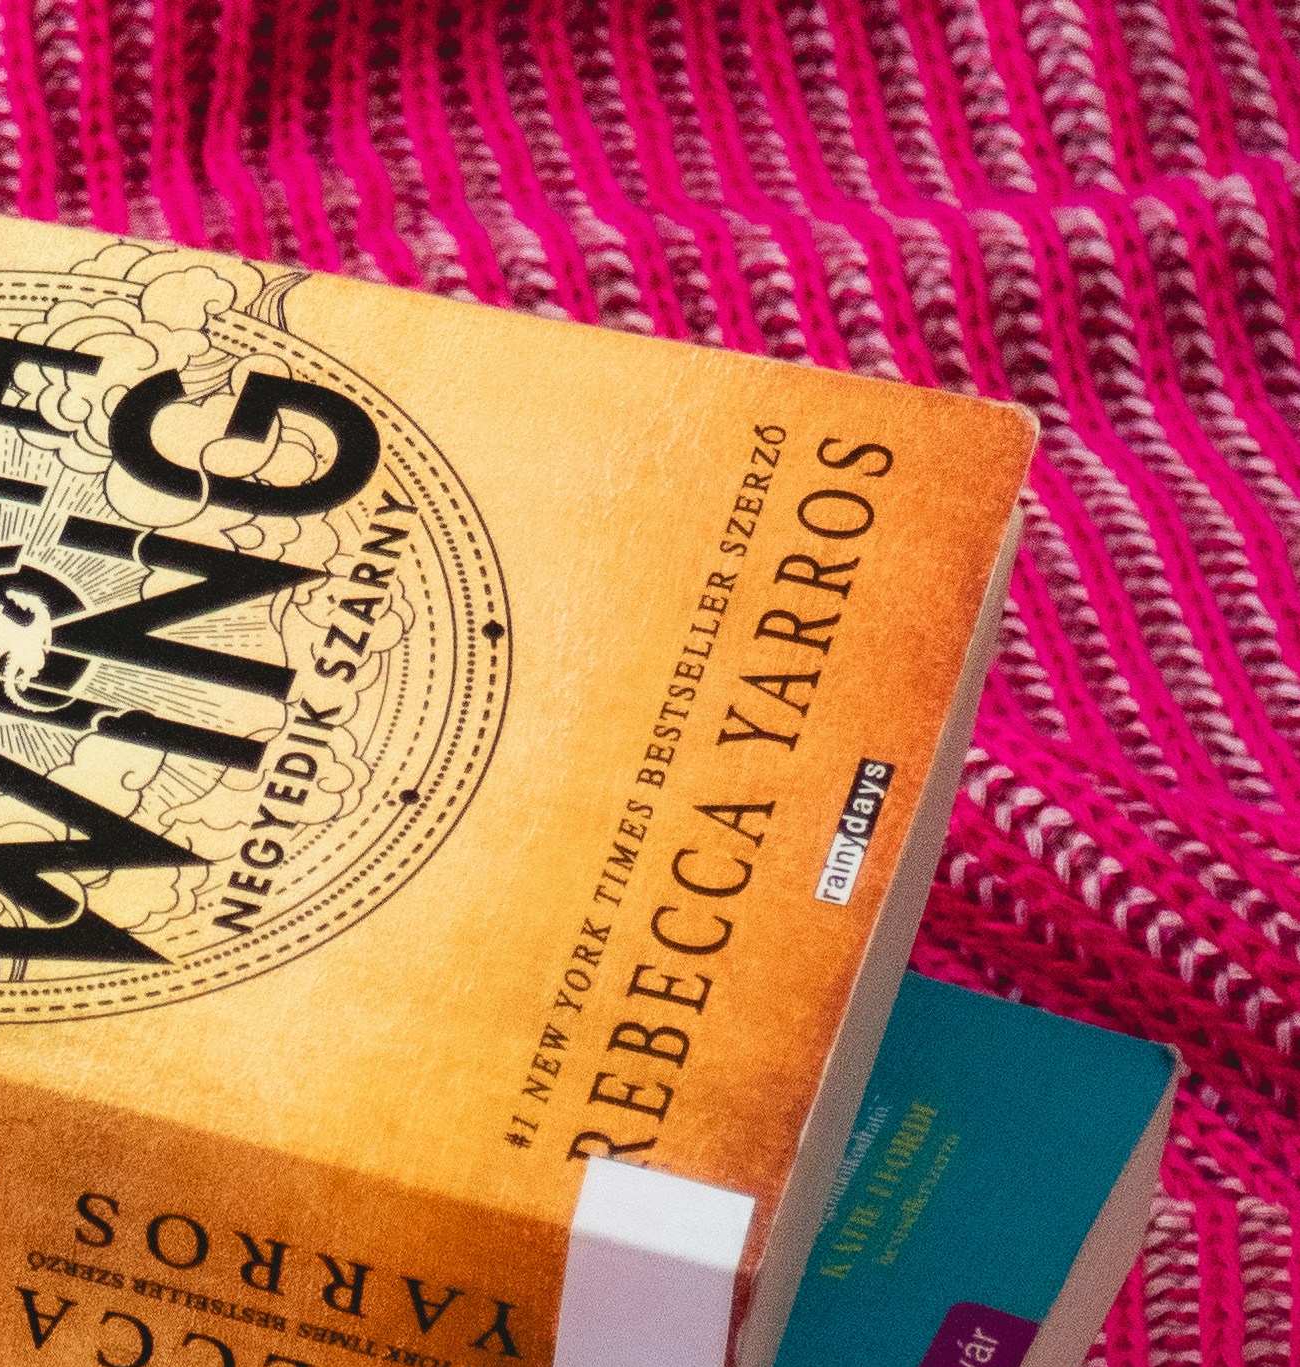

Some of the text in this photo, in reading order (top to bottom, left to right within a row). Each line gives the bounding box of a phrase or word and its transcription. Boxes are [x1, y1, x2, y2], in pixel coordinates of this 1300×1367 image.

[211, 490, 419, 936] NEGYEDIK SZÁRNY
[503, 424, 788, 1150] #1 NEW YORK TIMES BESTSELLER SZERZŐ
[566, 434, 895, 1166] REBECCA YARROS
[821, 763, 888, 904] rainydays
[27, 1249, 125, 1293] SZERZŐ
[72, 1190, 525, 1361] YARROS
[131, 1274, 287, 1334] BESTSELLER
[295, 1321, 377, 1359] TIMES
